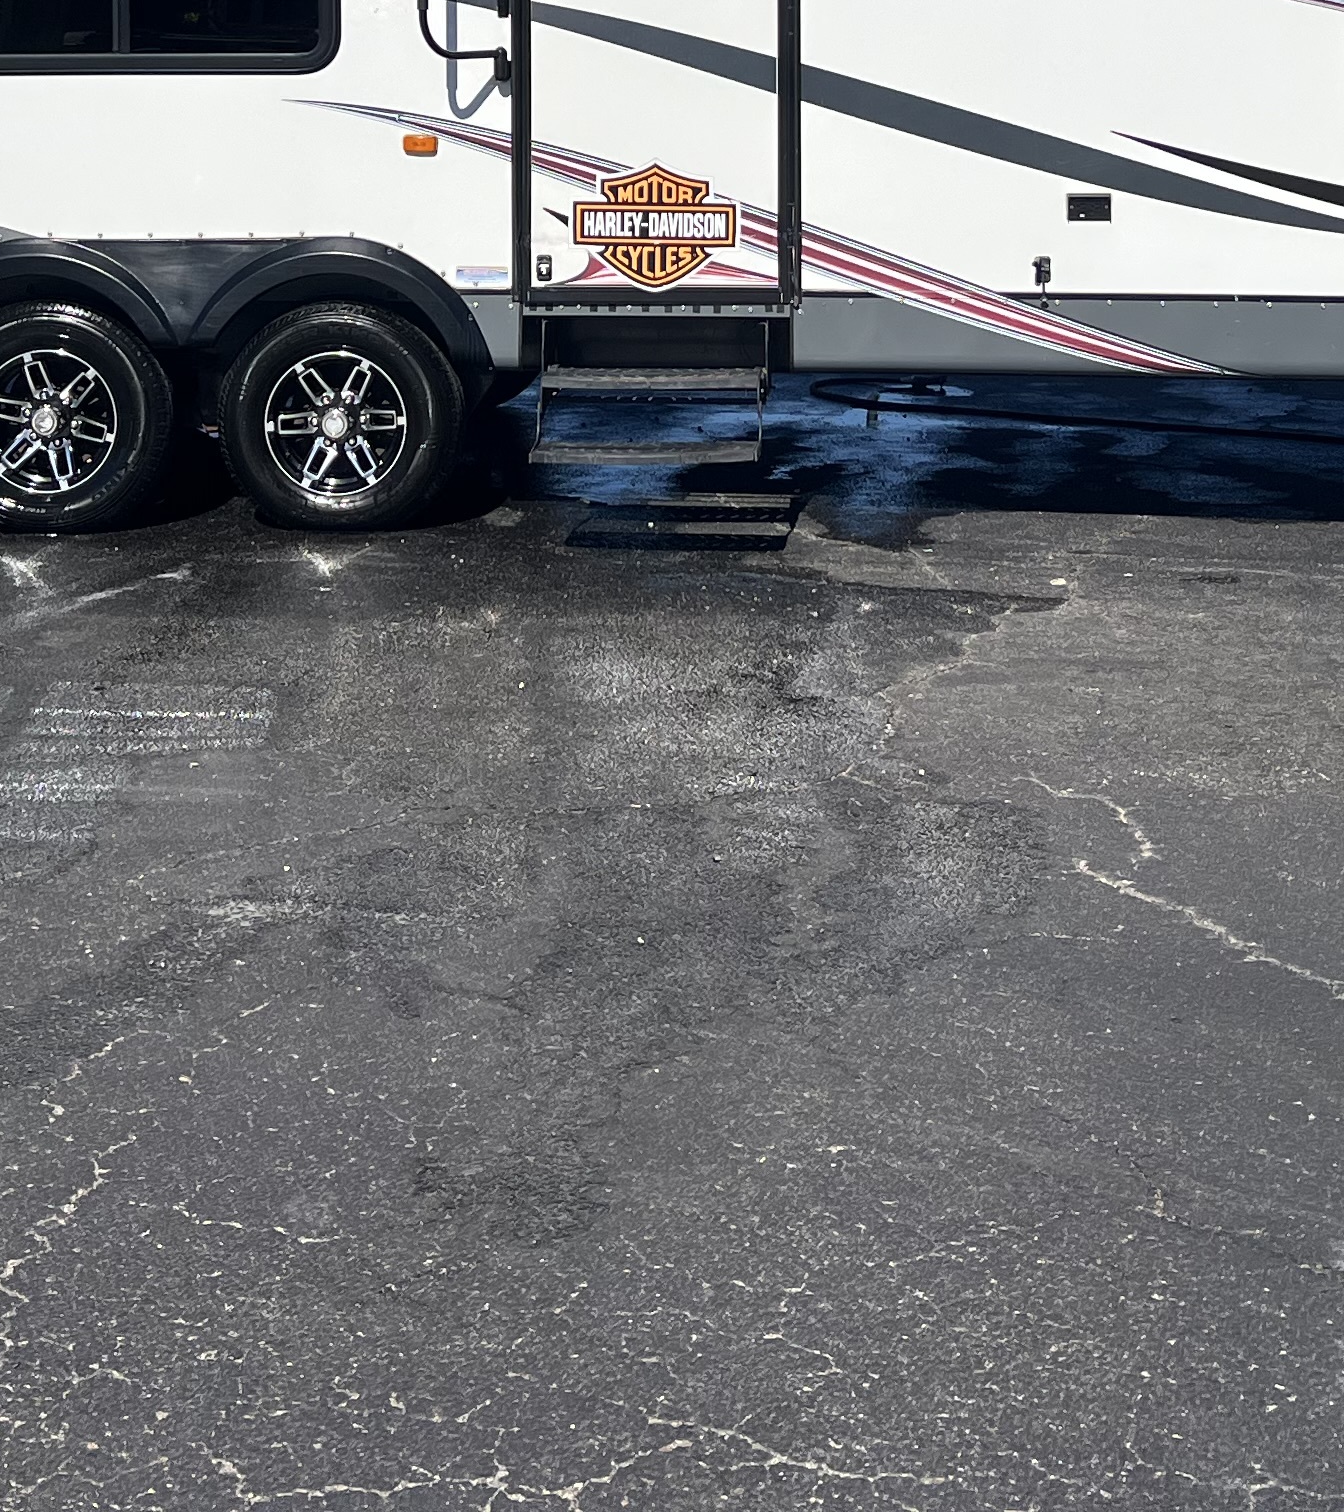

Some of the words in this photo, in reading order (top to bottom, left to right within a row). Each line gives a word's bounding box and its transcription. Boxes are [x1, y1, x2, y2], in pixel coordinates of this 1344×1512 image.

[617, 174, 693, 204] MOTOR
[583, 211, 726, 238] HARLEY-DAVIDSON
[616, 246, 692, 278] CYCLES
